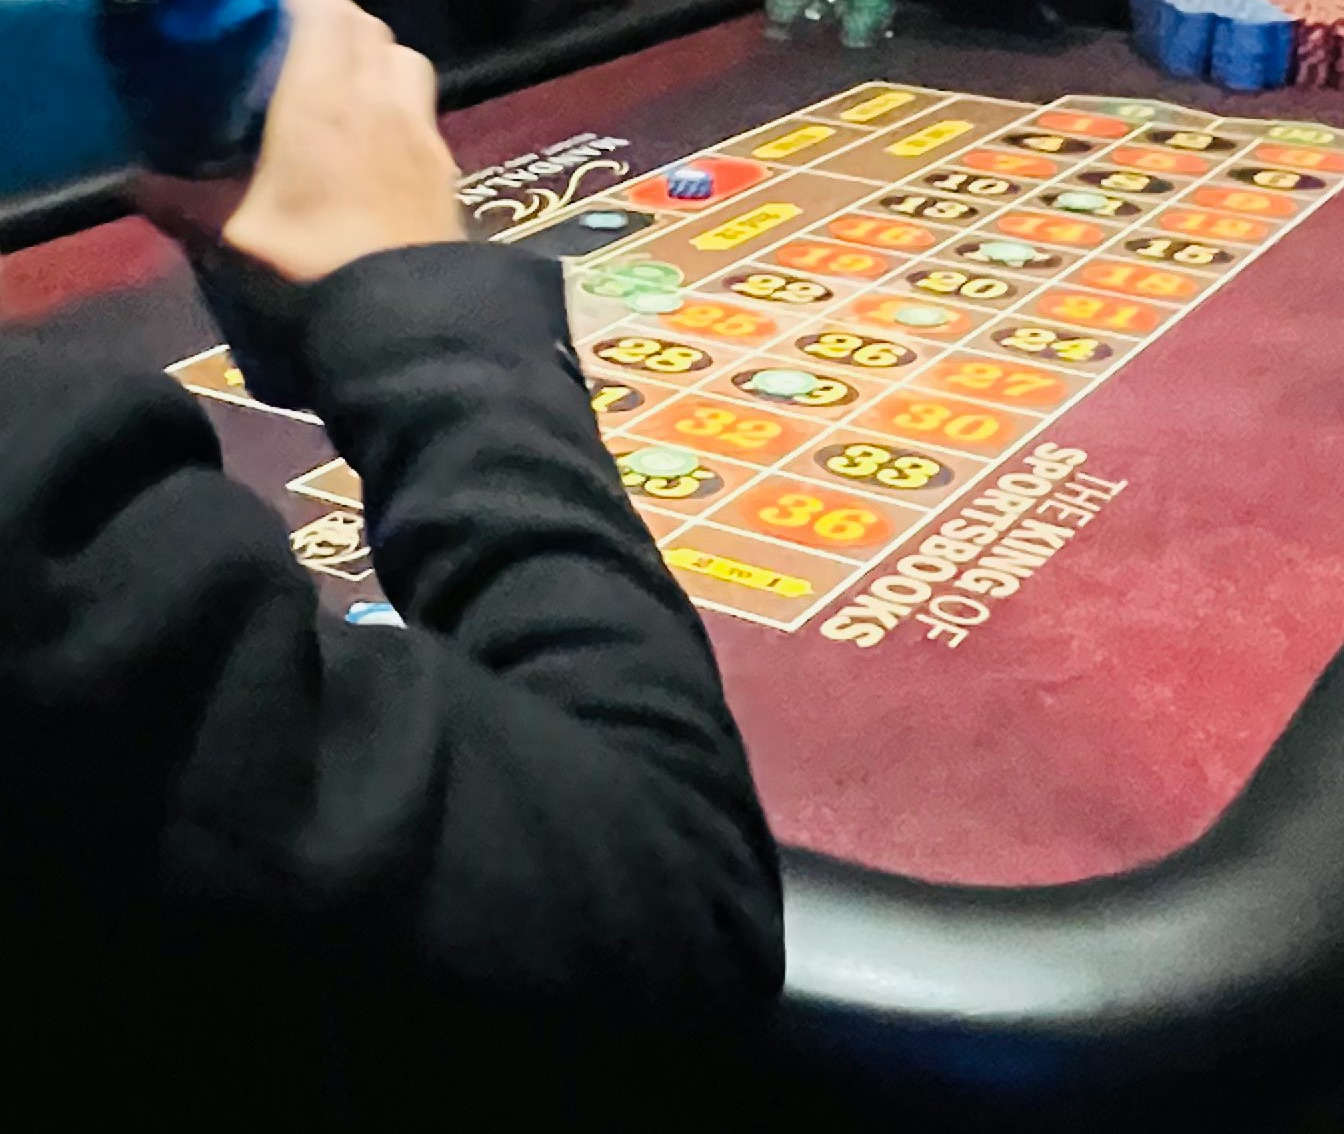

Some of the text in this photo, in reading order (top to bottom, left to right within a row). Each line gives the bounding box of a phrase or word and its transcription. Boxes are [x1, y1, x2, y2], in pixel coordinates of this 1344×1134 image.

[933, 173, 1010, 195] 10
[805, 246, 875, 274] 19
[731, 272, 826, 304] 22
[917, 270, 1009, 299] 20
[668, 304, 758, 337] 25
[599, 337, 703, 373] 28
[804, 332, 908, 368] 26
[1001, 327, 1100, 361] 24
[946, 362, 1055, 397] 27
[674, 406, 783, 449] 32
[892, 401, 1000, 442] 30
[826, 444, 942, 489] 33
[759, 493, 878, 542] 36
[820, 442, 1088, 648] SPORTSBOOKS
[915, 471, 1129, 648] THE KING OF
